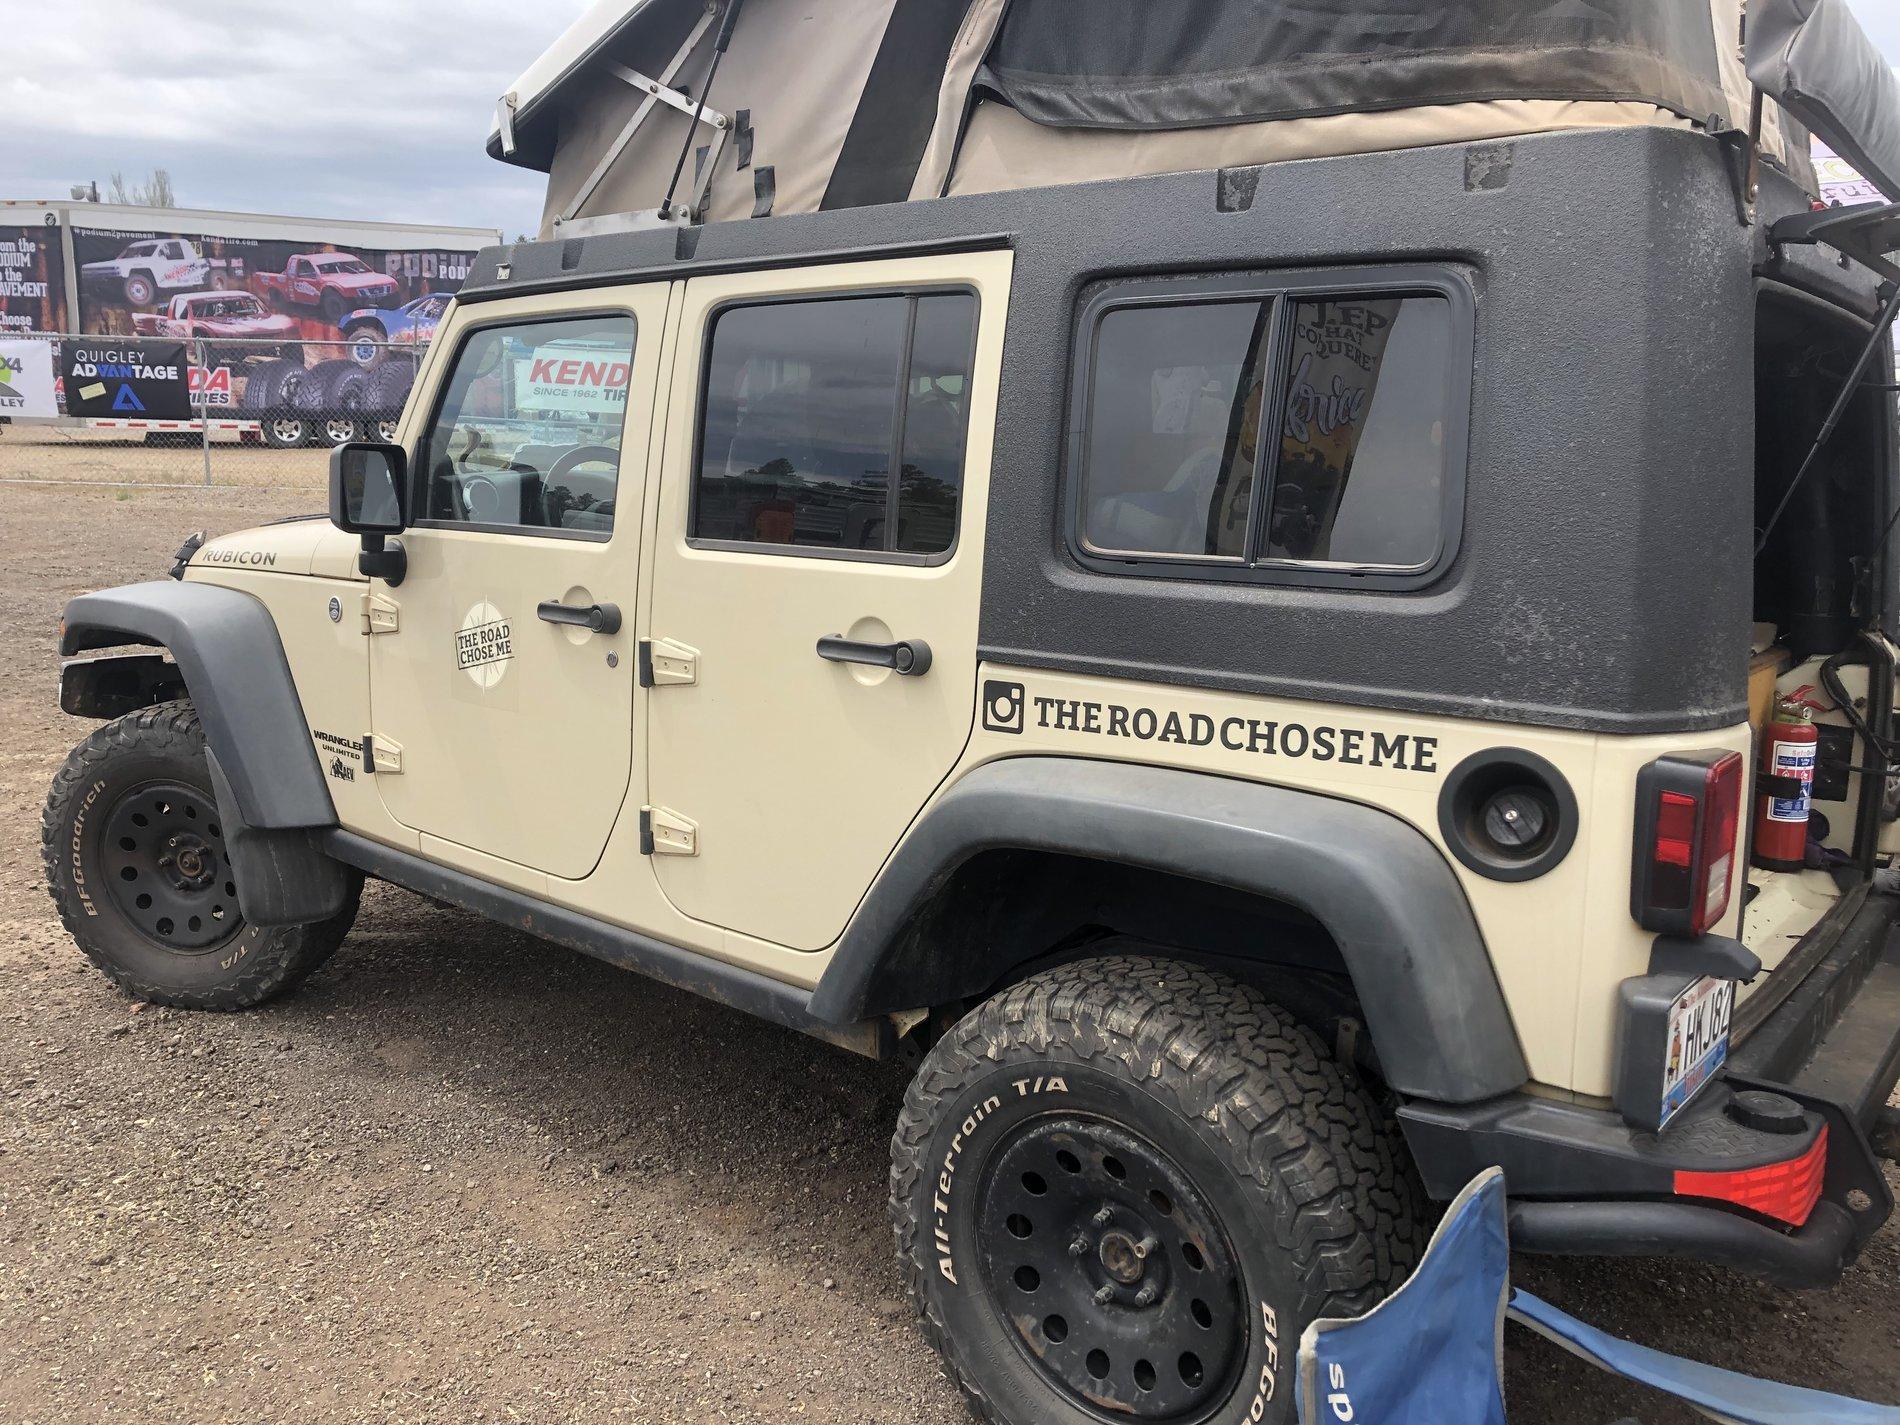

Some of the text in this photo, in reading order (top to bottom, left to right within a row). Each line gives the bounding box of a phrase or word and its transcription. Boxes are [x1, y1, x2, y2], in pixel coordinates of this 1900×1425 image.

[18, 237, 36, 252] the
[75, 349, 145, 364] QUIGLEY
[71, 363, 179, 380] ADVANTAGE
[529, 358, 630, 388] KEND
[533, 386, 569, 397] SINCE
[573, 388, 598, 399] 1962
[203, 550, 277, 566] RUBICON
[457, 624, 510, 650] THE ROAD
[460, 639, 512, 665] CHOSE ME
[322, 743, 361, 760] UNLIMITED
[1684, 980, 1732, 1071] HKJ82
[934, 1076, 1069, 1285] All-Terrain T/A
